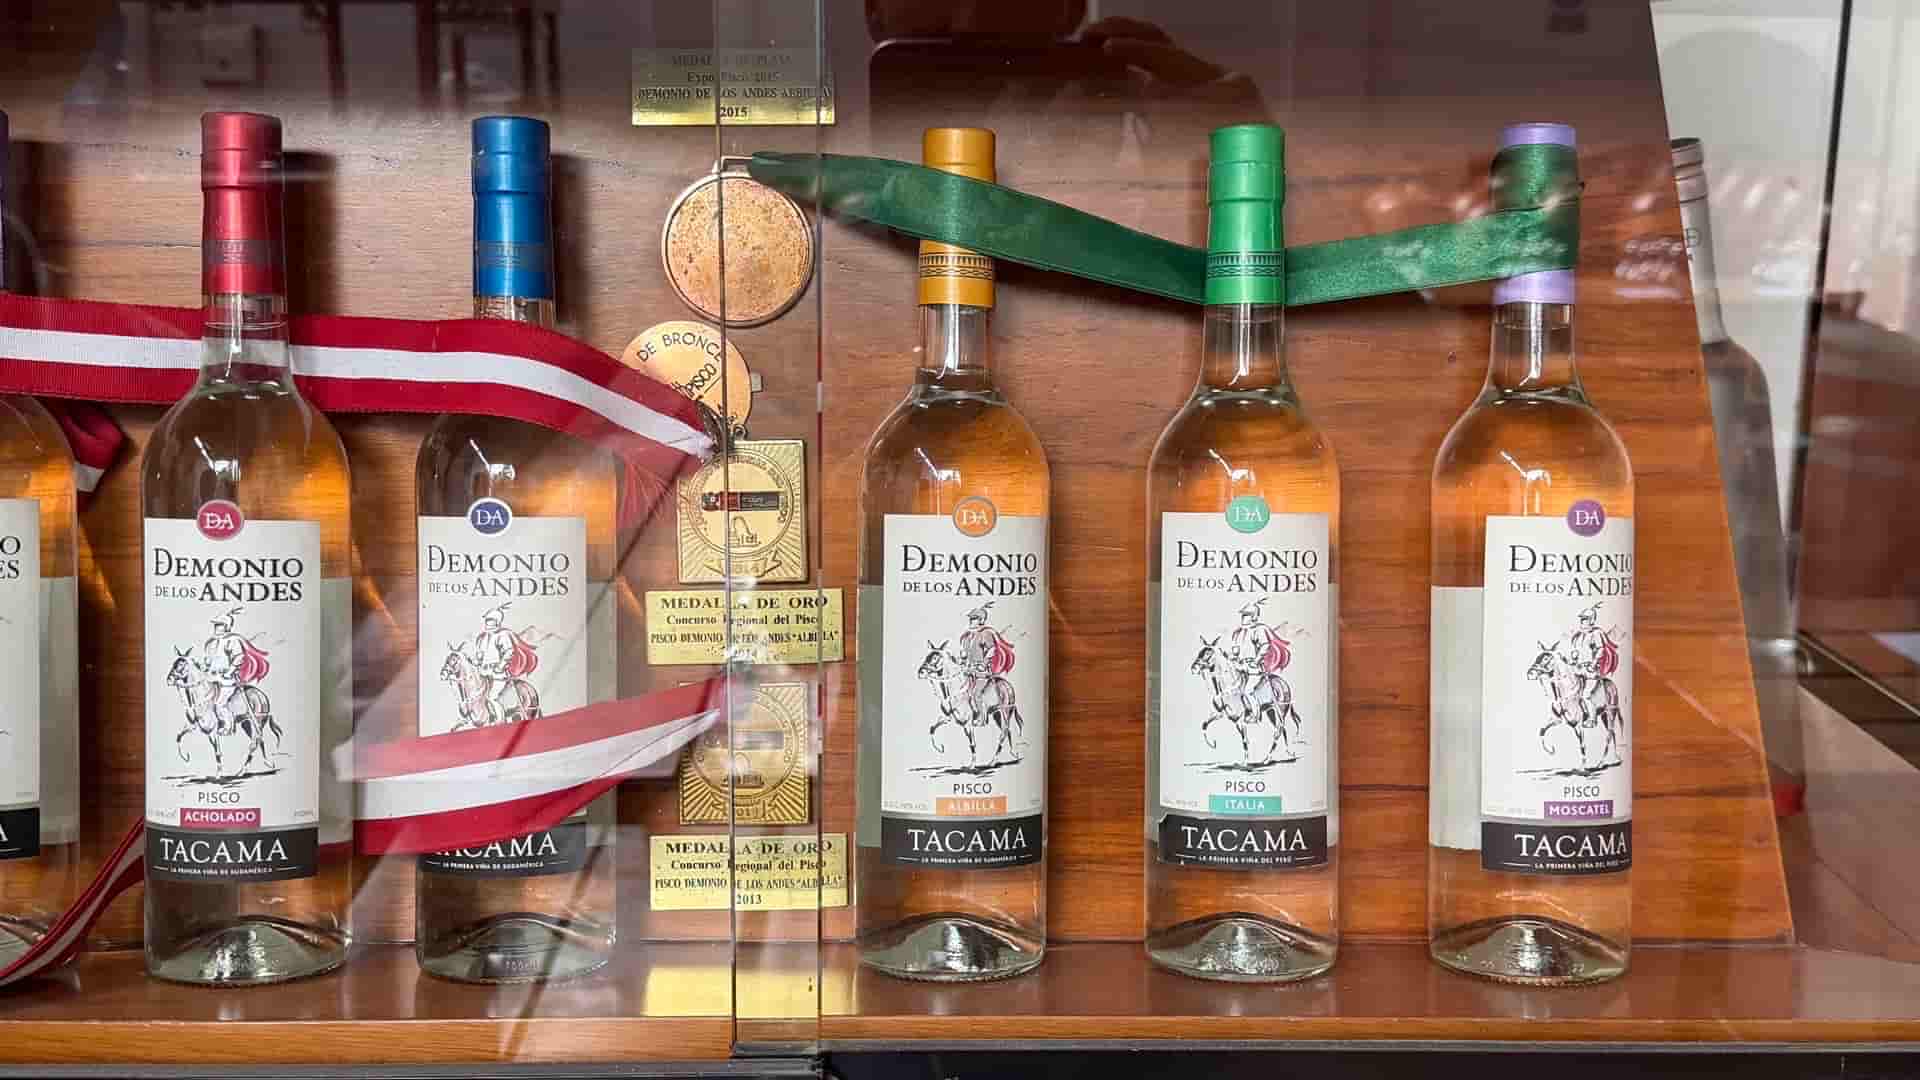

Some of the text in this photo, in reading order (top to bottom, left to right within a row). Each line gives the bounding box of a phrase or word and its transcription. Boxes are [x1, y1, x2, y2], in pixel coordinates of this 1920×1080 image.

[687, 71, 715, 86] Expo
[695, 87, 711, 98] DE
[742, 87, 777, 98] ANDES
[719, 105, 748, 118] 2015
[636, 342, 657, 362] DE
[427, 544, 570, 573] DEMONIO
[901, 544, 1038, 573] DEMONIO
[1175, 540, 1318, 569] DEMONIO
[152, 547, 304, 578] DEMONIO
[428, 576, 569, 597] DE LOS ANDES
[903, 576, 1037, 596] DE LOS ANDES
[1177, 573, 1317, 593] DE LOS ANDES
[1510, 582, 1532, 593] DE
[1536, 582, 1565, 594] LOS
[155, 581, 304, 602] DE LOS ANDES
[661, 596, 828, 609] MEDALA DE ORO
[666, 614, 717, 625] Concurso
[774, 613, 790, 625] del
[651, 632, 677, 644] PISCO
[680, 632, 724, 643] DEMONIO
[953, 782, 993, 795] PISCO
[1225, 780, 1266, 793] PISCO
[1563, 785, 1600, 798] PISCO
[198, 791, 241, 804] PISCO
[1224, 799, 1265, 812] ITALIA
[1549, 804, 1610, 816] MOSCATEL
[184, 810, 257, 823] ACHOLADO
[906, 825, 1027, 853] TACAMA
[1180, 825, 1309, 853] TACAMA
[1513, 831, 1628, 858] TACAMA
[159, 836, 289, 864] TACAMA
[666, 841, 833, 856] MEDALA DE ORO
[671, 860, 721, 870] Concurso
[778, 859, 794, 871] del
[655, 879, 681, 889] PISCO
[683, 879, 728, 889] DEMONIO
[745, 880, 763, 890] LOS
[767, 879, 796, 889] ANDES
[736, 893, 762, 905] 2013
